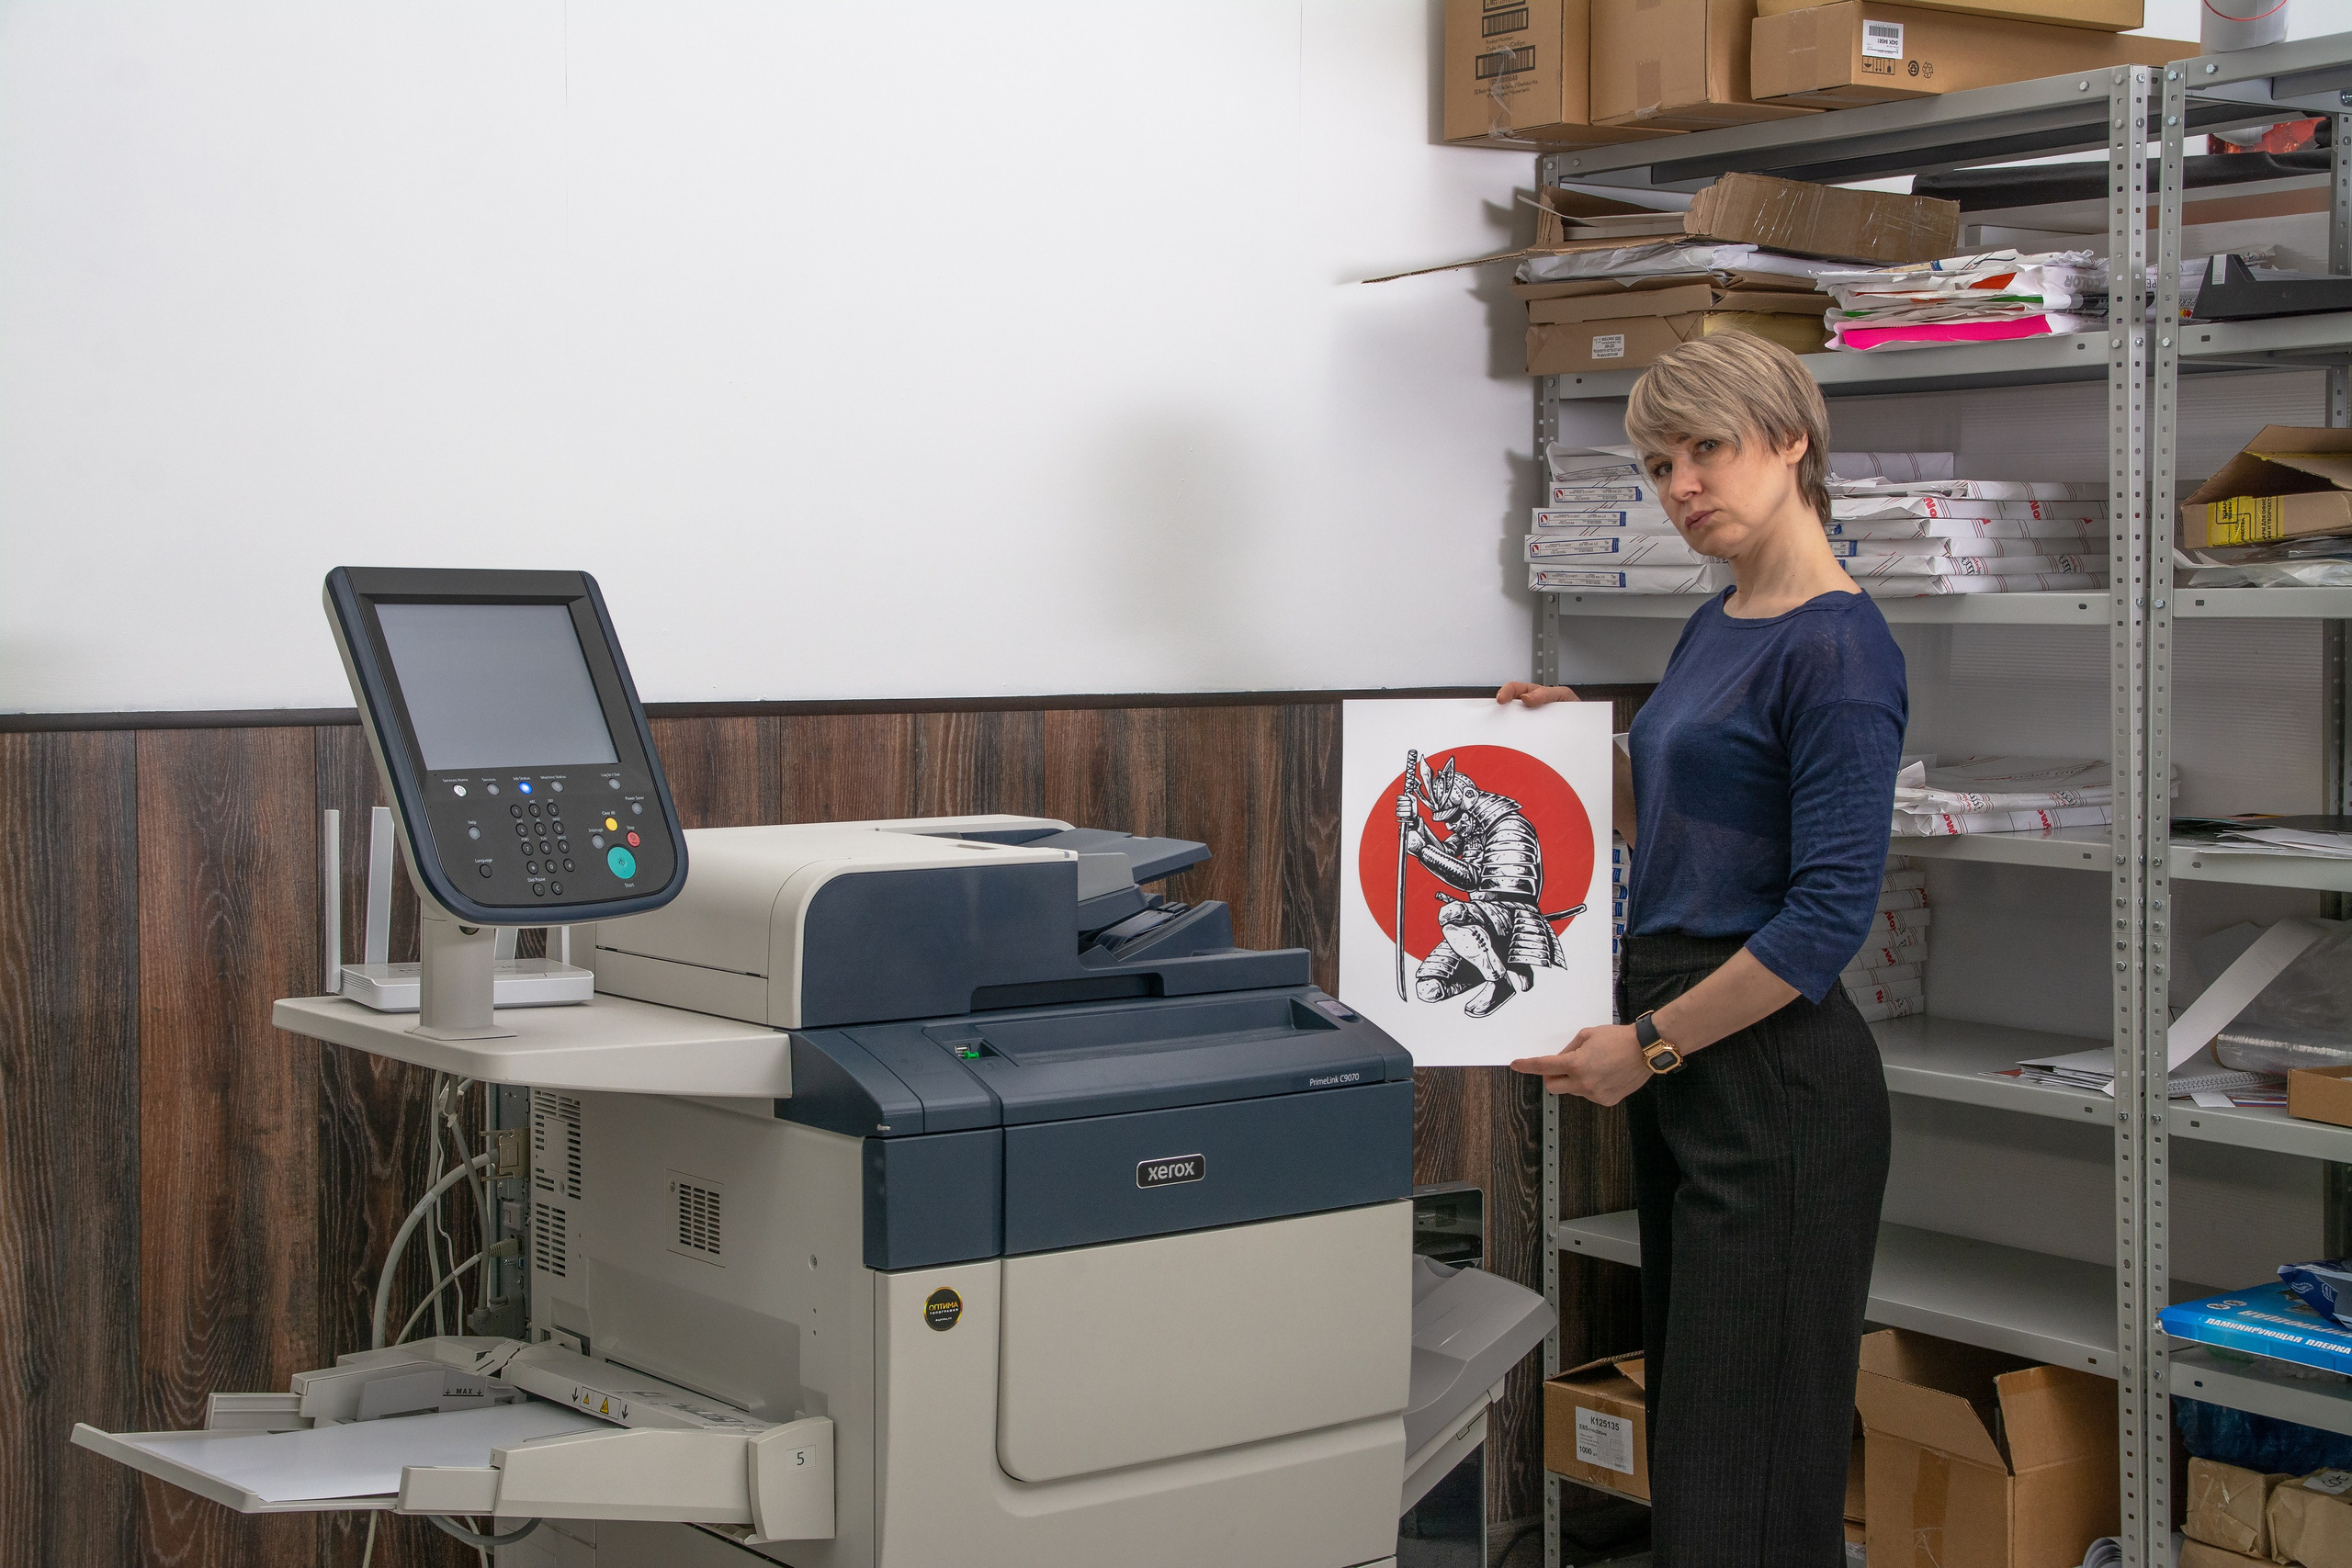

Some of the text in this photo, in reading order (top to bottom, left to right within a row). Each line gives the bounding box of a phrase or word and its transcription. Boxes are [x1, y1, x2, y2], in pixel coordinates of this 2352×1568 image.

[1309, 1073, 1360, 1087] PrimeLink C9070
[1148, 1161, 1194, 1181] xerox
[928, 1302, 958, 1312] ОПТИМА
[2205, 1317, 2352, 1355] ЛАМИНИРУЮЩАЯ ПЛЕНКА
[1590, 1416, 1620, 1431] K125135
[797, 1451, 805, 1466] 5
[1578, 1446, 1592, 1456] 1000
